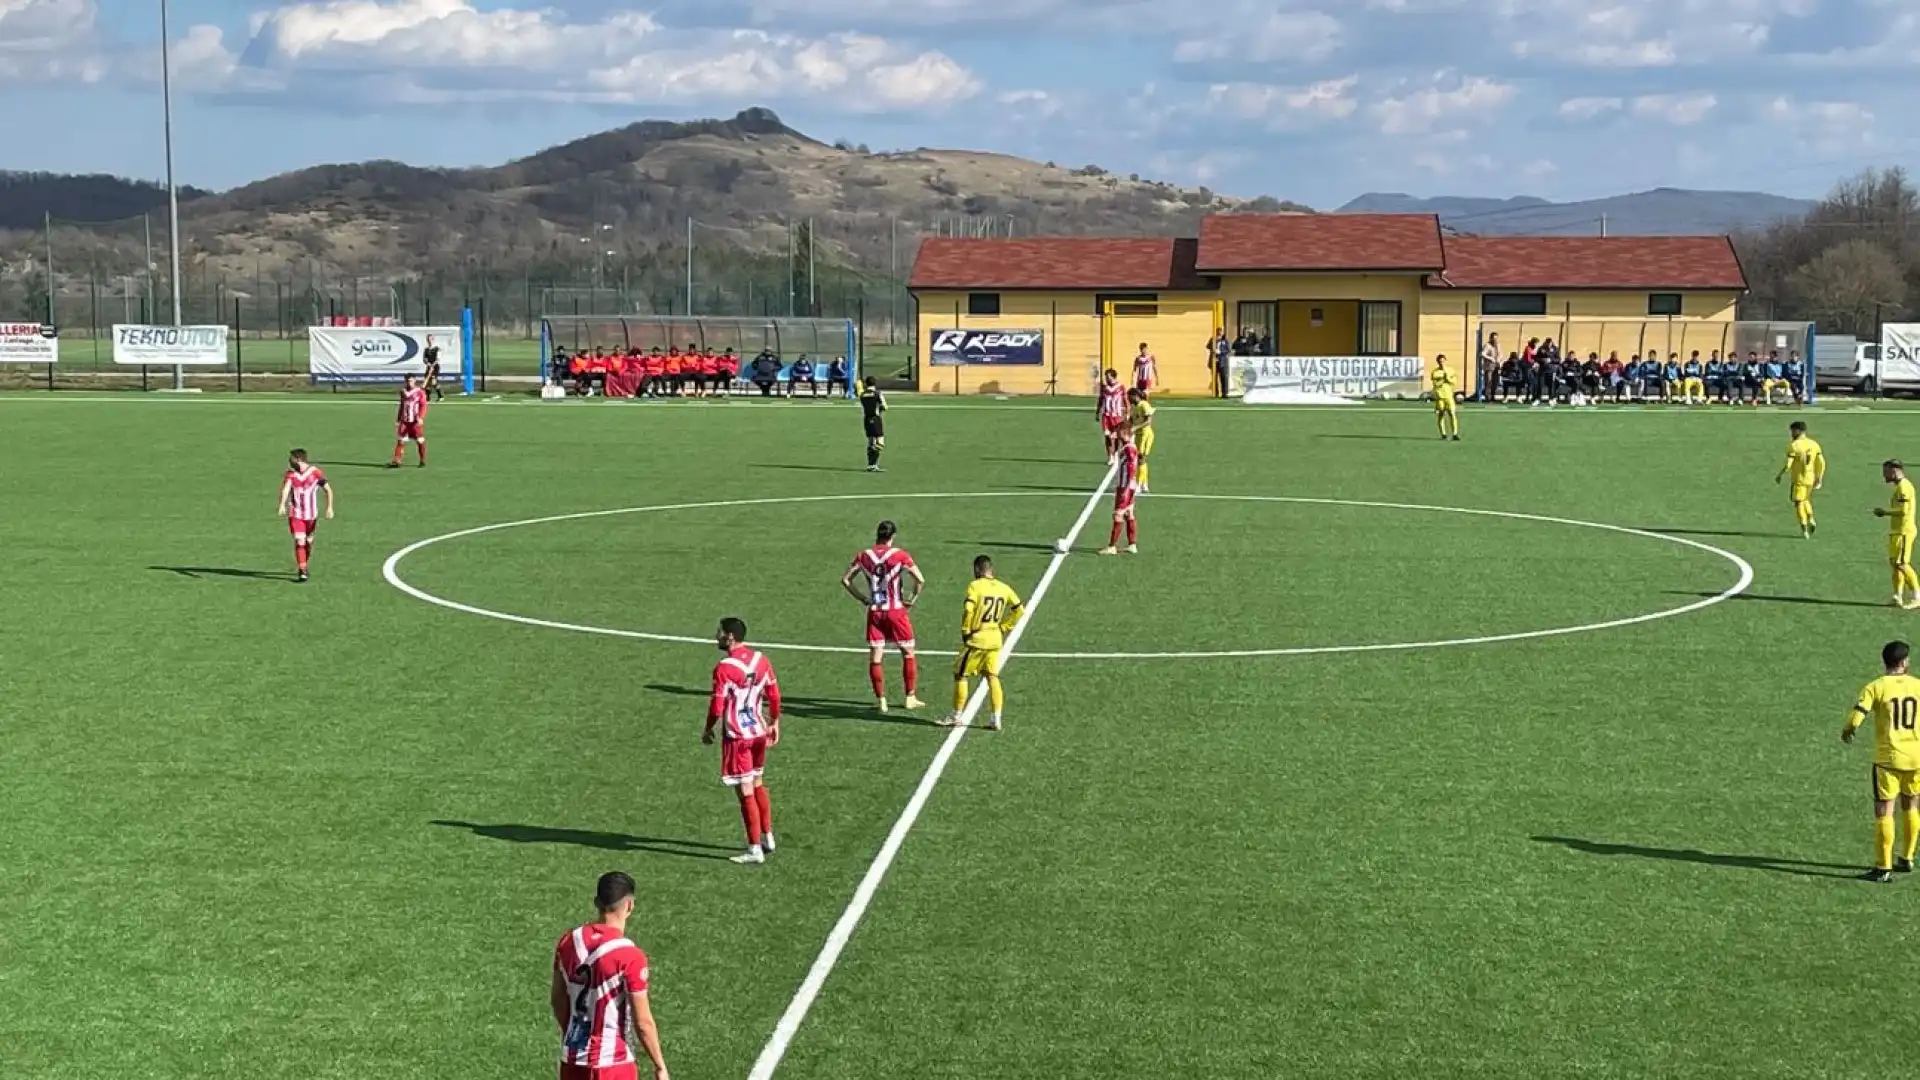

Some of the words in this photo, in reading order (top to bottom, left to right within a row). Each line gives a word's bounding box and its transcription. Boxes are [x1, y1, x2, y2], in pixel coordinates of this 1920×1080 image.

[964, 333, 1041, 352] READY
[1301, 378, 1378, 393] CALCIO
[875, 563, 886, 585] 9
[981, 596, 1005, 622] 20
[744, 672, 756, 709] 7
[1890, 696, 1917, 730] 10
[575, 963, 592, 1015] 2
